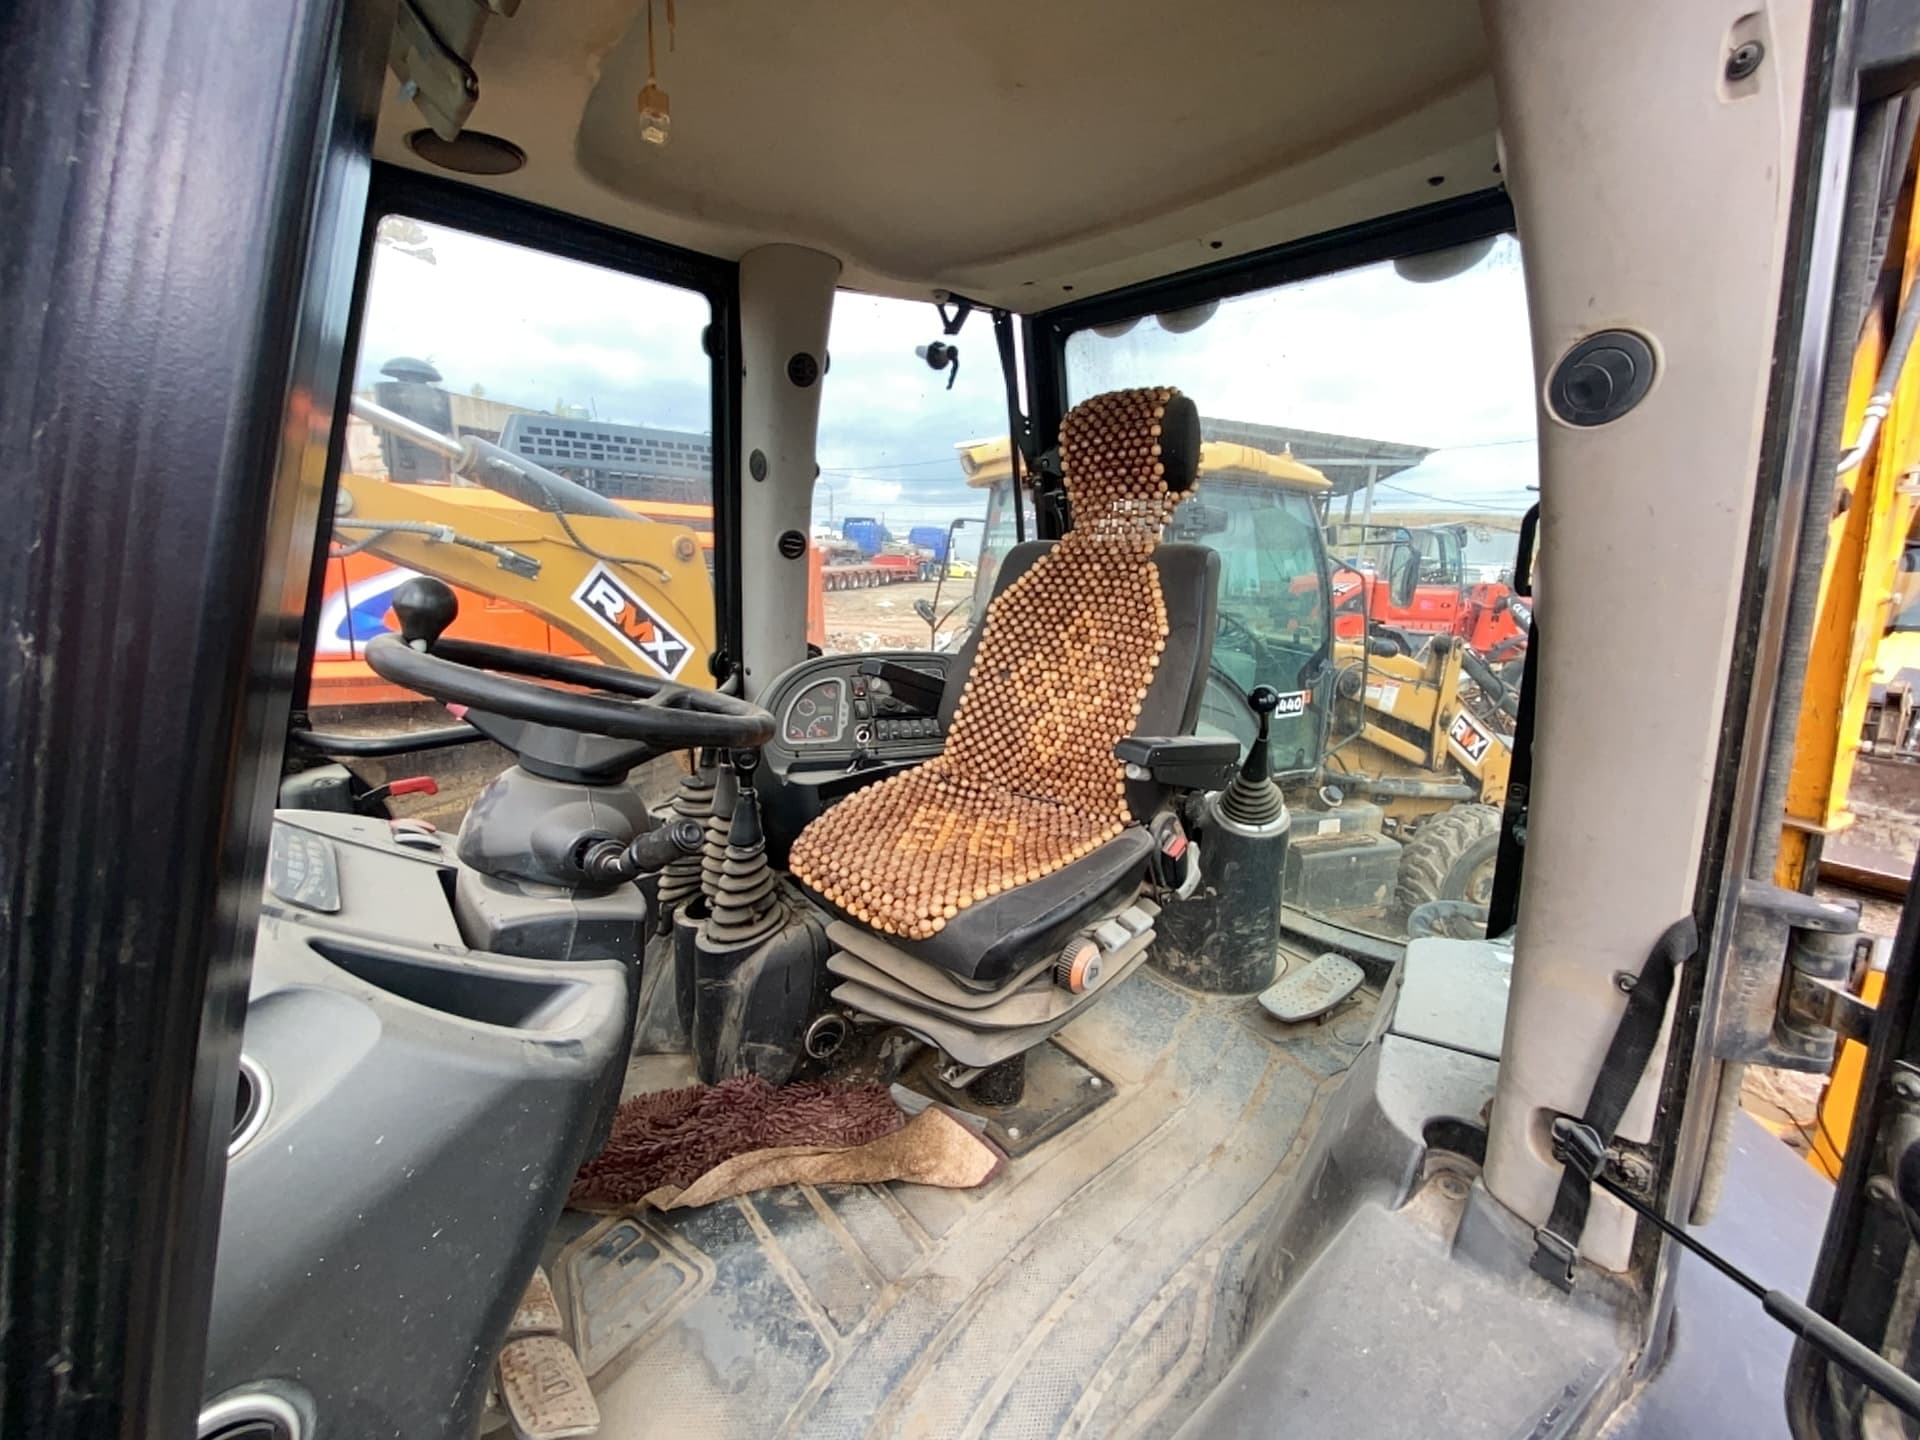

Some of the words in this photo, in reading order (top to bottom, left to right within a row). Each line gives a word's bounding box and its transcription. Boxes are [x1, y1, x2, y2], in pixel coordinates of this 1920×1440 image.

[586, 577, 685, 667] RMX
[1279, 697, 1302, 712] 440
[1451, 717, 1488, 758] RMX
